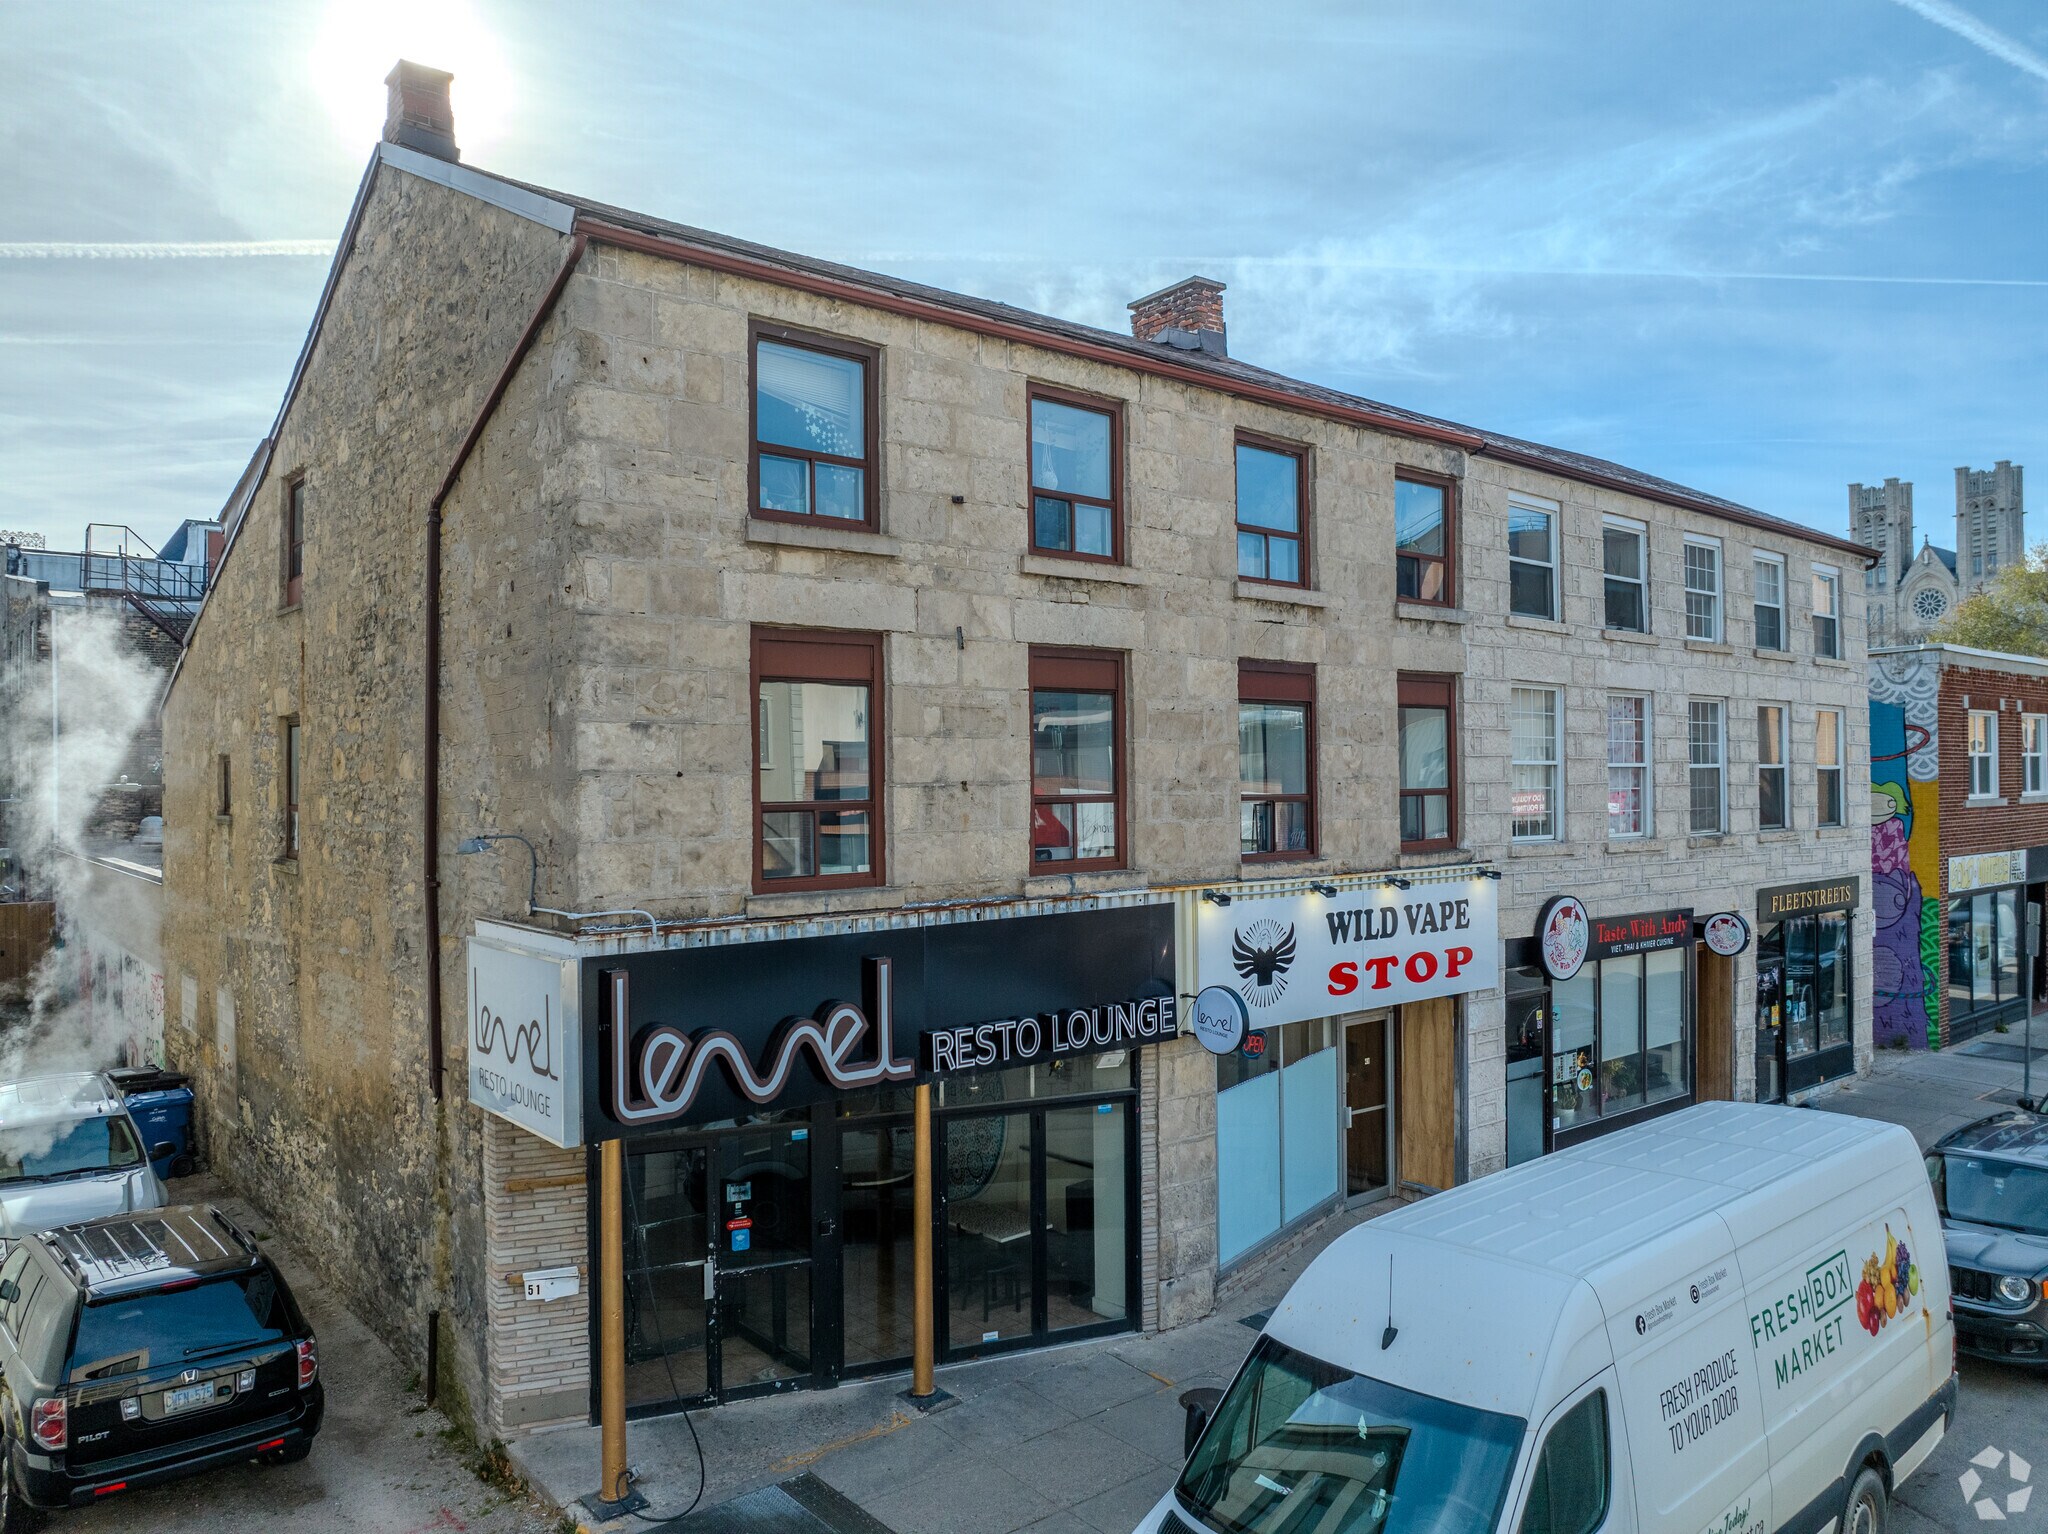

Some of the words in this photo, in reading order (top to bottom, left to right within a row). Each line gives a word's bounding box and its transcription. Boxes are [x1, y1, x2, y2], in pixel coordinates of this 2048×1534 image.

[1325, 906, 1398, 945] WILD
[1404, 899, 1470, 936] VAPE
[1771, 885, 1851, 913] FLEETSTREETS
[1597, 923, 1627, 943] Taste
[1630, 917, 1657, 938] With
[1659, 913, 1688, 938] Andy
[1624, 943, 1635, 952] THAI
[1327, 946, 1473, 996] STOP
[932, 1017, 1041, 1073] RESTO
[1052, 996, 1176, 1053] LOUNGE
[478, 1067, 507, 1097] RESTO
[510, 1083, 552, 1118] LOUNGE
[527, 1284, 541, 1297] 51
[1750, 1285, 1811, 1349] FRESH
[1811, 1262, 1848, 1309] BOX
[1774, 1315, 1844, 1390] MARKET
[1659, 1377, 1693, 1422] FRESH
[1694, 1349, 1739, 1401] PRODUCE
[77, 1430, 110, 1444] PILOT
[1668, 1420, 1684, 1454] TO
[1683, 1401, 1712, 1443] YOUR
[1709, 1385, 1740, 1429] DOOR
